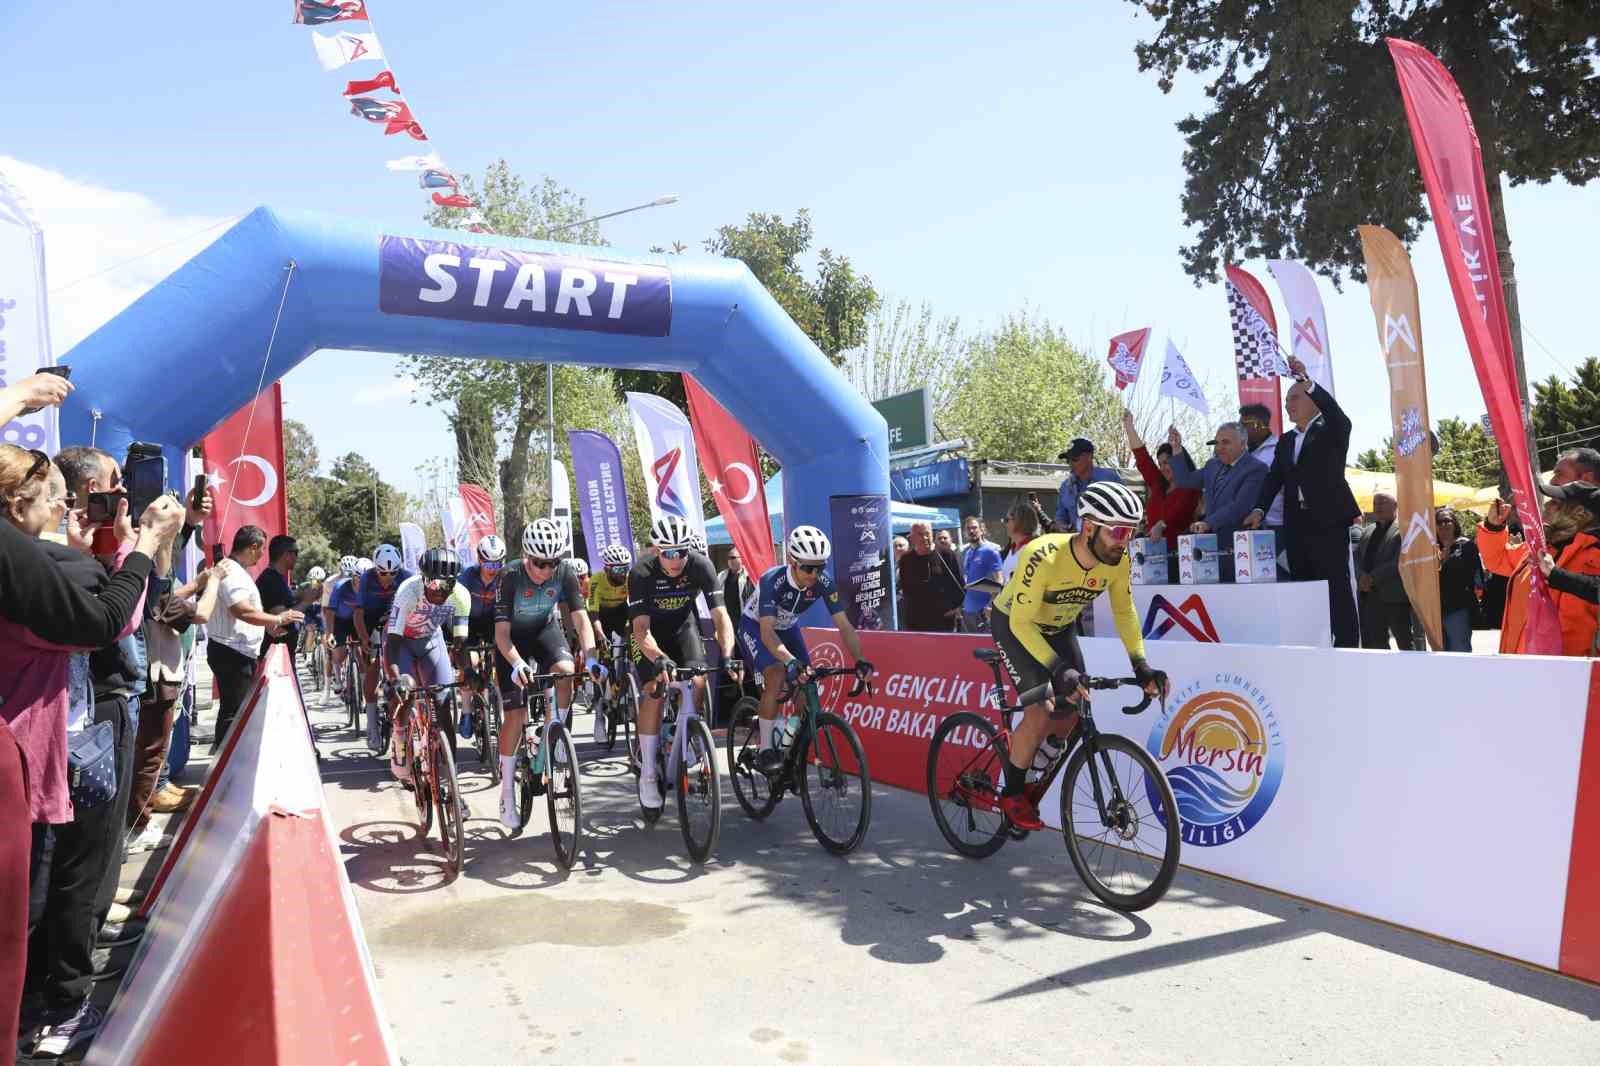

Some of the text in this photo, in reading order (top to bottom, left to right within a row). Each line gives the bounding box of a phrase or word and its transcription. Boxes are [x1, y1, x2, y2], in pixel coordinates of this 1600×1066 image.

[418, 253, 638, 319] START
[888, 427, 902, 443] FE
[905, 473, 939, 490] RIHTIM
[1022, 543, 1059, 588] KONYA
[1056, 589, 1098, 600] KONYA
[885, 673, 973, 708] GENÇLİK
[842, 702, 885, 730] SPOR
[1157, 728, 1263, 777] Mersin
